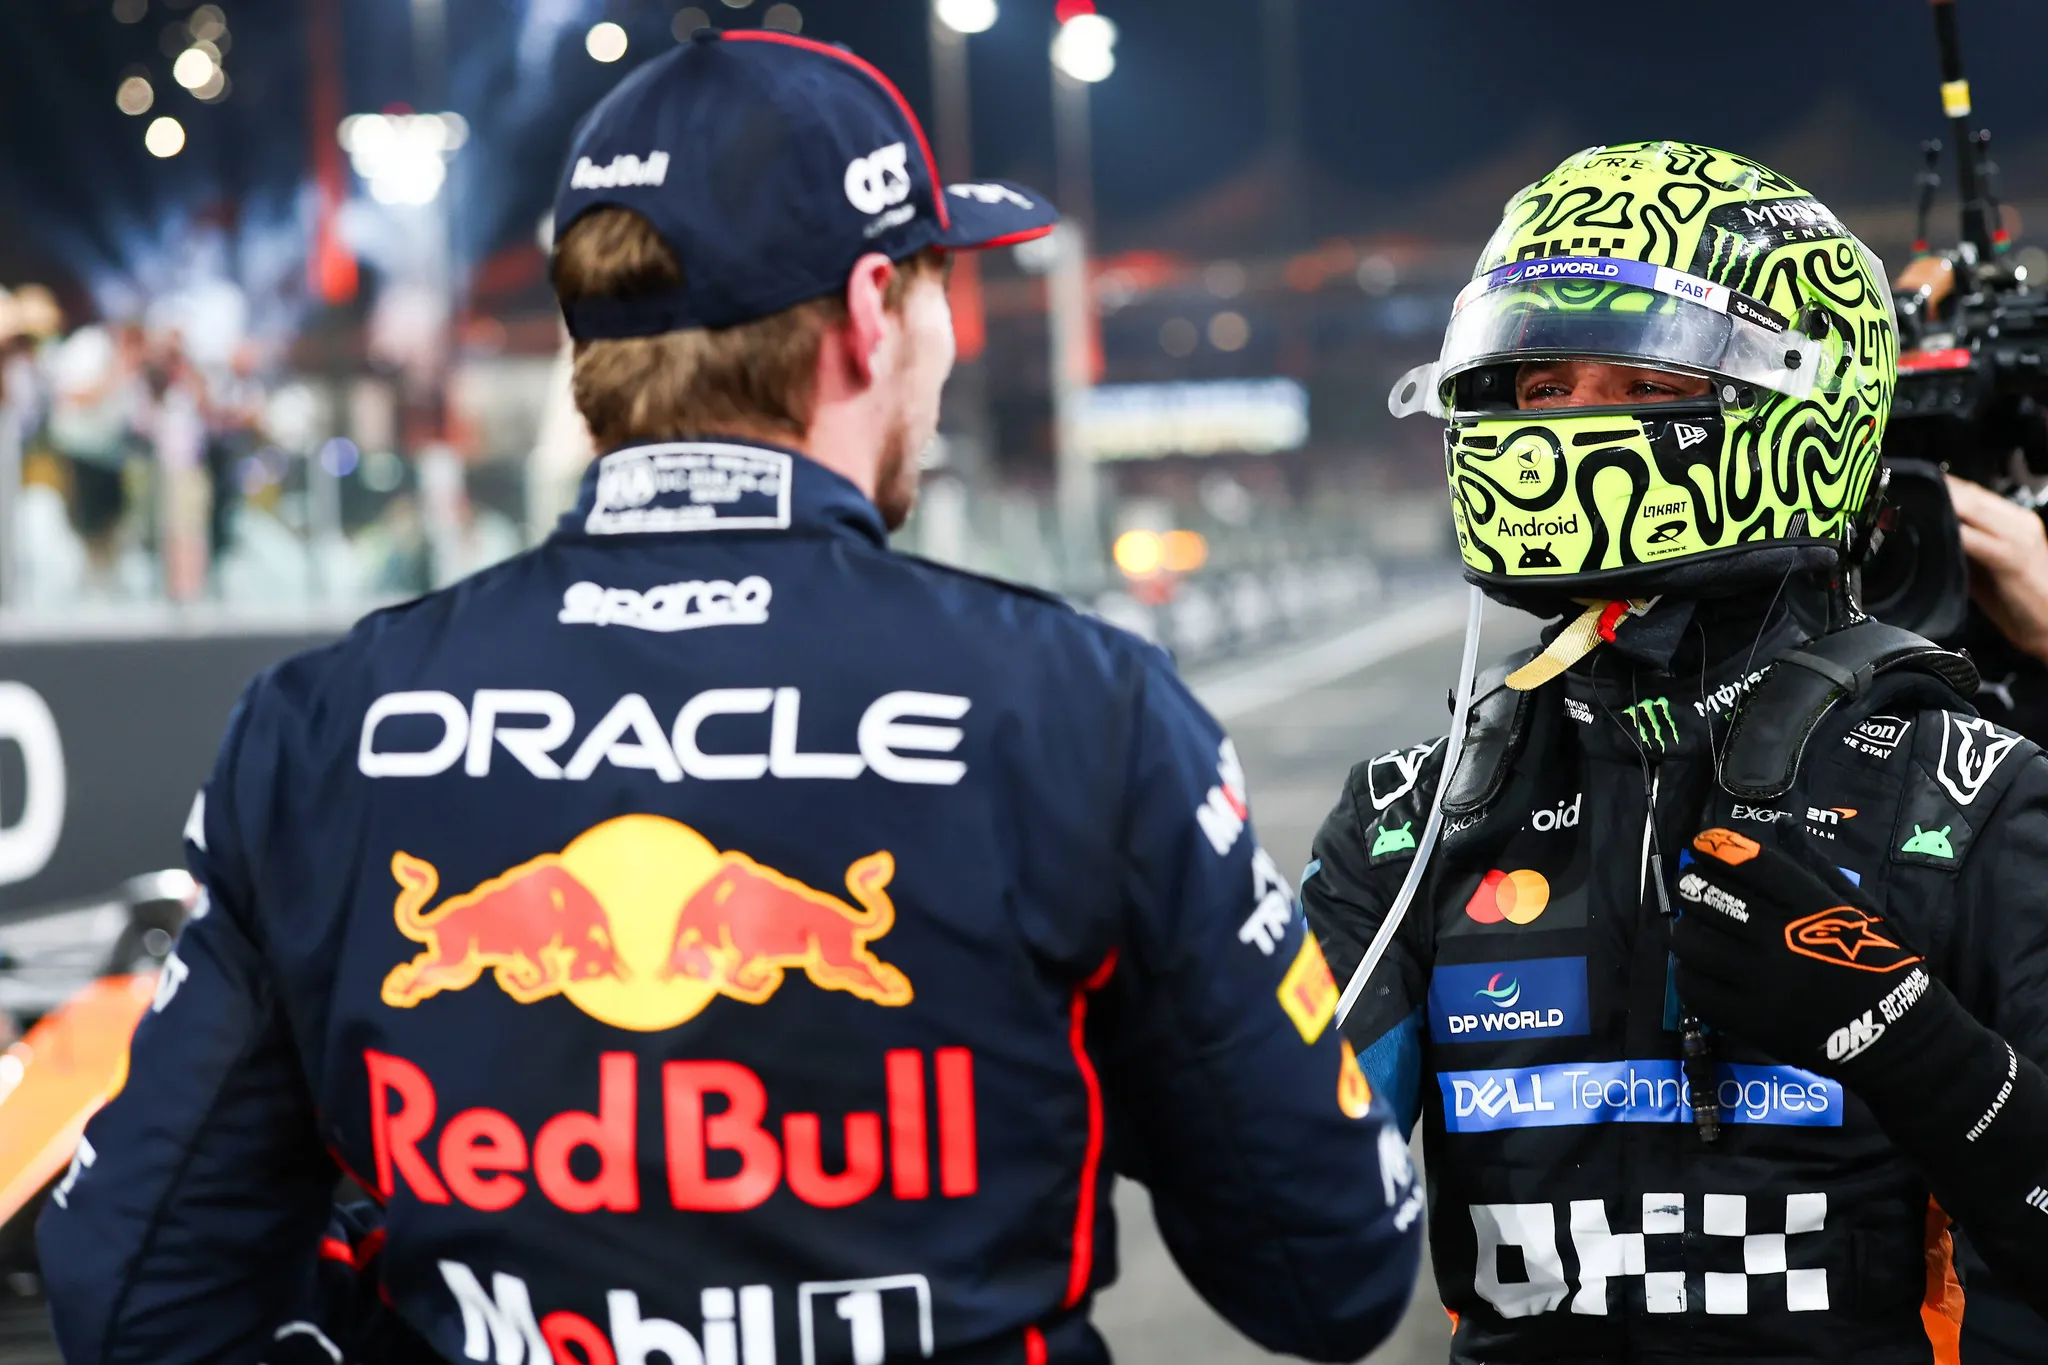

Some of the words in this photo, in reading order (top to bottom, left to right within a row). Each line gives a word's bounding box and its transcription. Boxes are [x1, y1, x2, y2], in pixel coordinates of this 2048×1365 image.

[1525, 263, 1549, 278] DP
[1551, 262, 1620, 277] WORLD
[1748, 307, 1784, 333] Dropbox
[1497, 513, 1579, 537] Android
[358, 687, 972, 785] ORACLE
[1860, 743, 1892, 760] STAY
[1805, 825, 1835, 841] TEAM
[1878, 967, 1925, 1013] OPTIMUM
[1448, 1013, 1479, 1035] DP
[1481, 1008, 1565, 1032] WORLD
[1826, 1009, 1874, 1061] ON
[1884, 973, 1930, 1024] NUTRITION
[1452, 1072, 1556, 1119] DELL
[1965, 1080, 2013, 1142] RICHARD
[363, 1048, 640, 1213] Red
[662, 1046, 978, 1213] Bull
[1469, 1192, 1830, 1320] OKX
[437, 1258, 777, 1365] Mobil
[836, 1287, 886, 1365] 1
